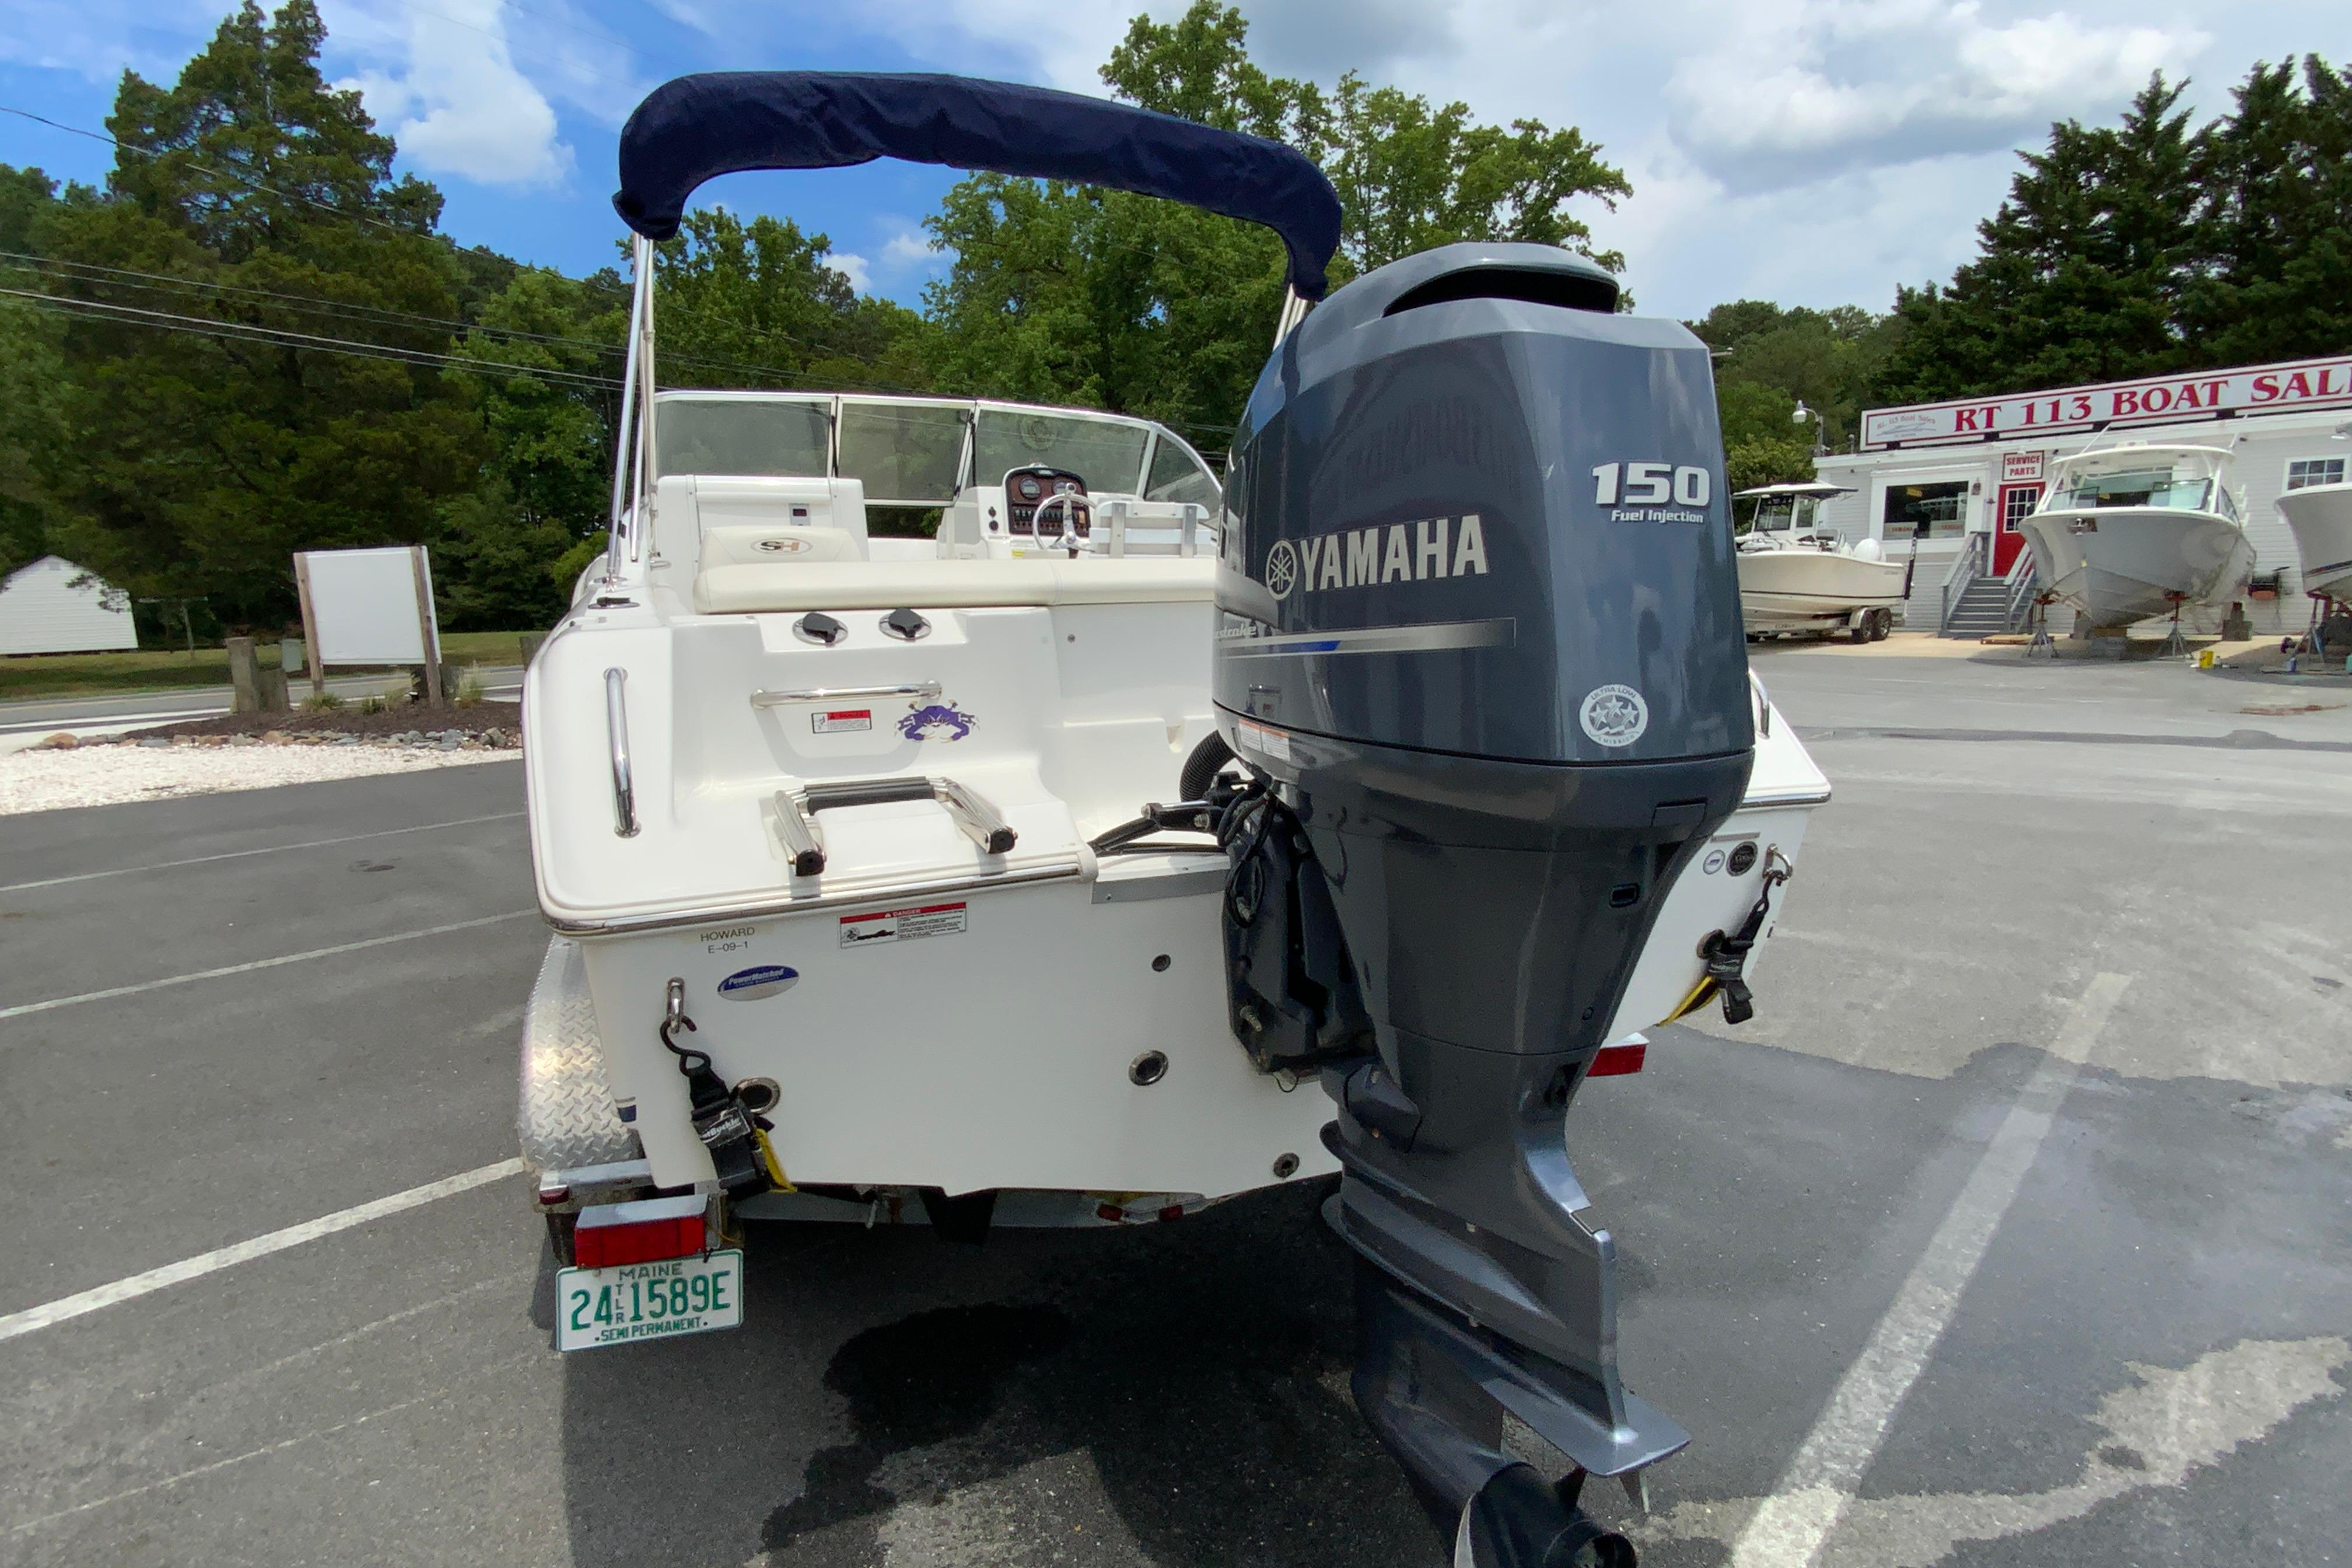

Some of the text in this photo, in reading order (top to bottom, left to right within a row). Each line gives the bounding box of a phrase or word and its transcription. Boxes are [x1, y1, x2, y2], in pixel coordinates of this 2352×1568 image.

[1954, 366, 2352, 432] RT 113 BOAT SAL
[2006, 455, 2041, 466] SERVICE
[2010, 467, 2036, 476] PARTS
[1592, 463, 1710, 506] 150
[1611, 509, 1704, 524] Fuel Injection
[1301, 514, 1488, 593] YAMAHA
[1590, 686, 1636, 700] ULTRA LOW
[892, 908, 922, 917] DANGER
[701, 926, 755, 942] HOWARD
[708, 941, 748, 954] E-09-1
[618, 1262, 684, 1282] MAINE
[570, 1269, 732, 1331] 24 1589E
[600, 1316, 702, 1342] SEMI PERMANENT
